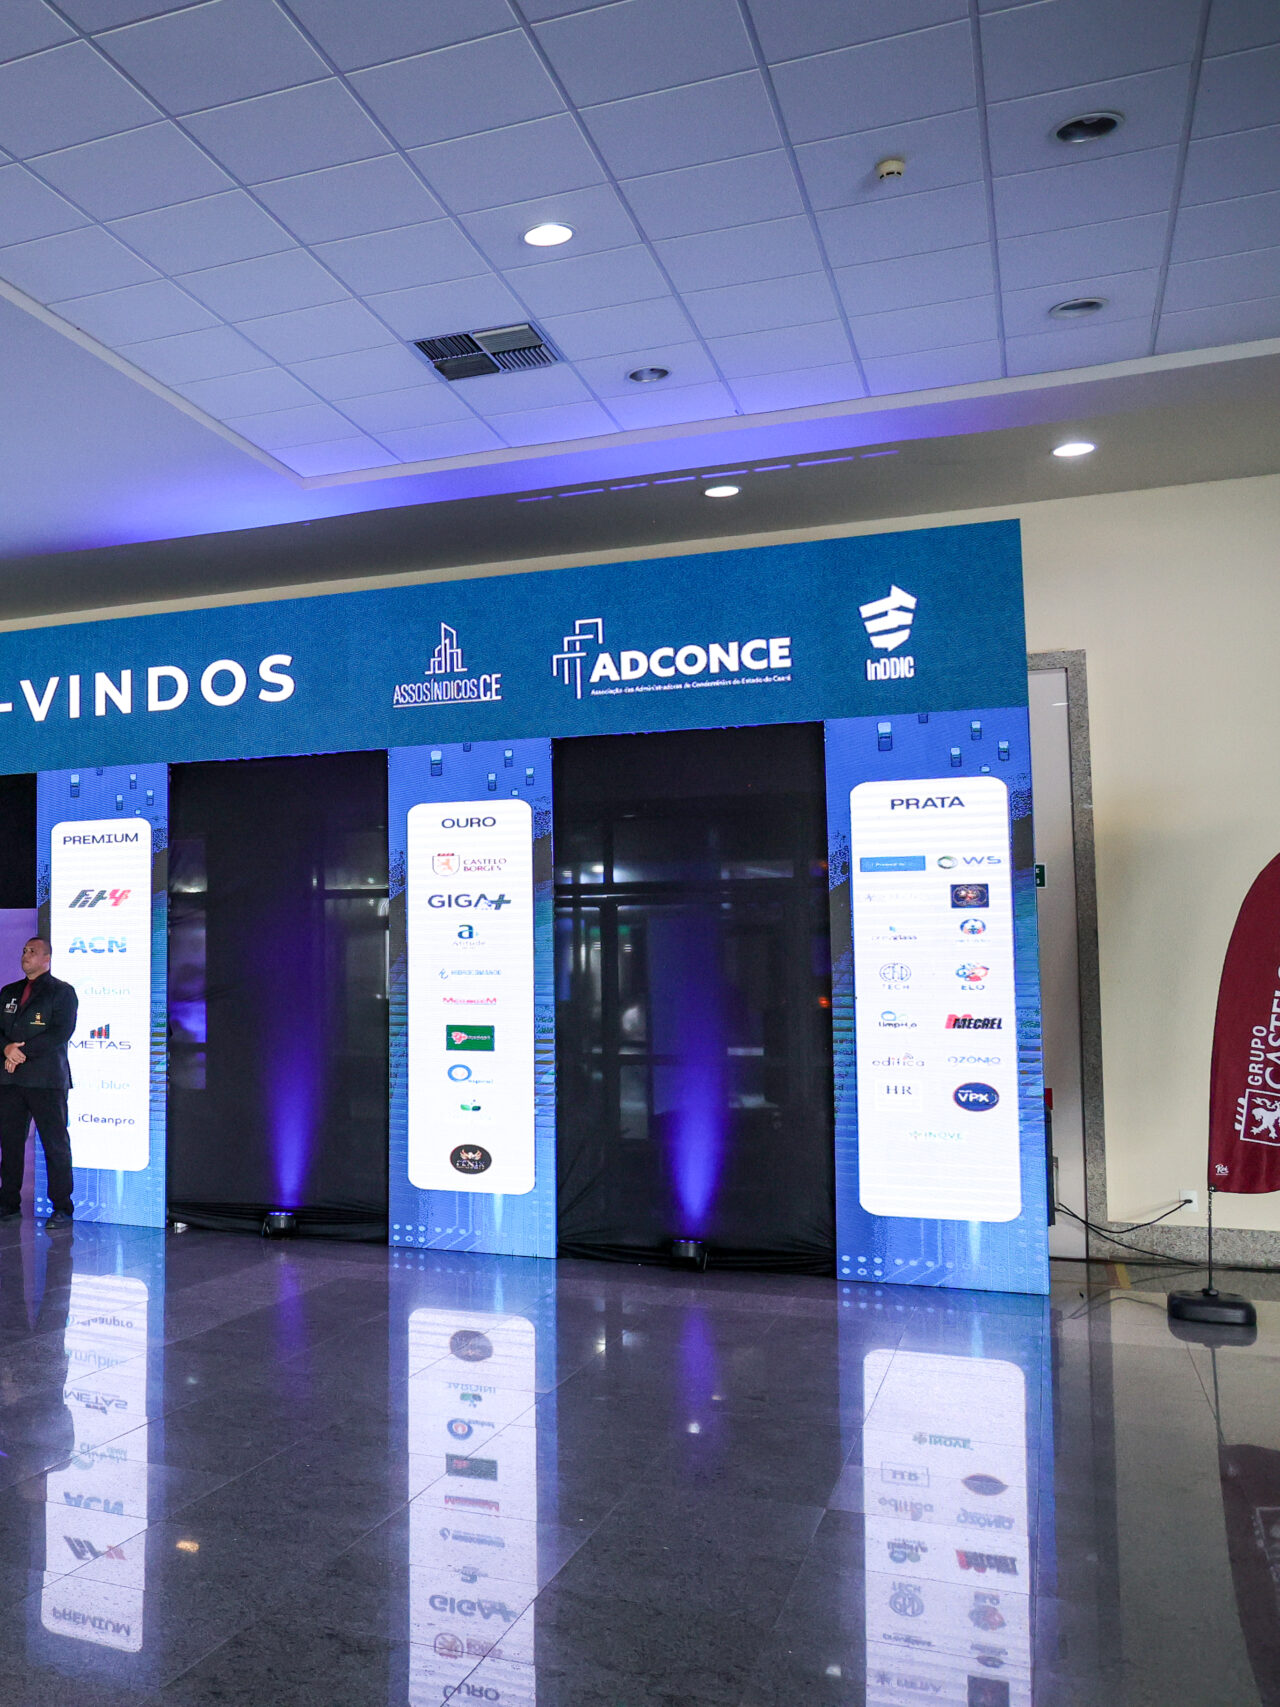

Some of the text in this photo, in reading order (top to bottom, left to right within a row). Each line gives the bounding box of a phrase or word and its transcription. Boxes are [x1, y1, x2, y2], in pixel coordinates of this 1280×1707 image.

[590, 637, 792, 684] ADCONCE
[891, 796, 965, 810] PRATA
[441, 816, 497, 829] OURO
[63, 833, 139, 846] PREMIUM
[962, 856, 1002, 865] WS
[68, 936, 127, 953] ACN
[68, 1040, 132, 1050] METAS
[1248, 1025, 1268, 1086] GRUPO
[957, 1092, 990, 1102] VPX
[78, 1113, 136, 1126] iCleanpro
